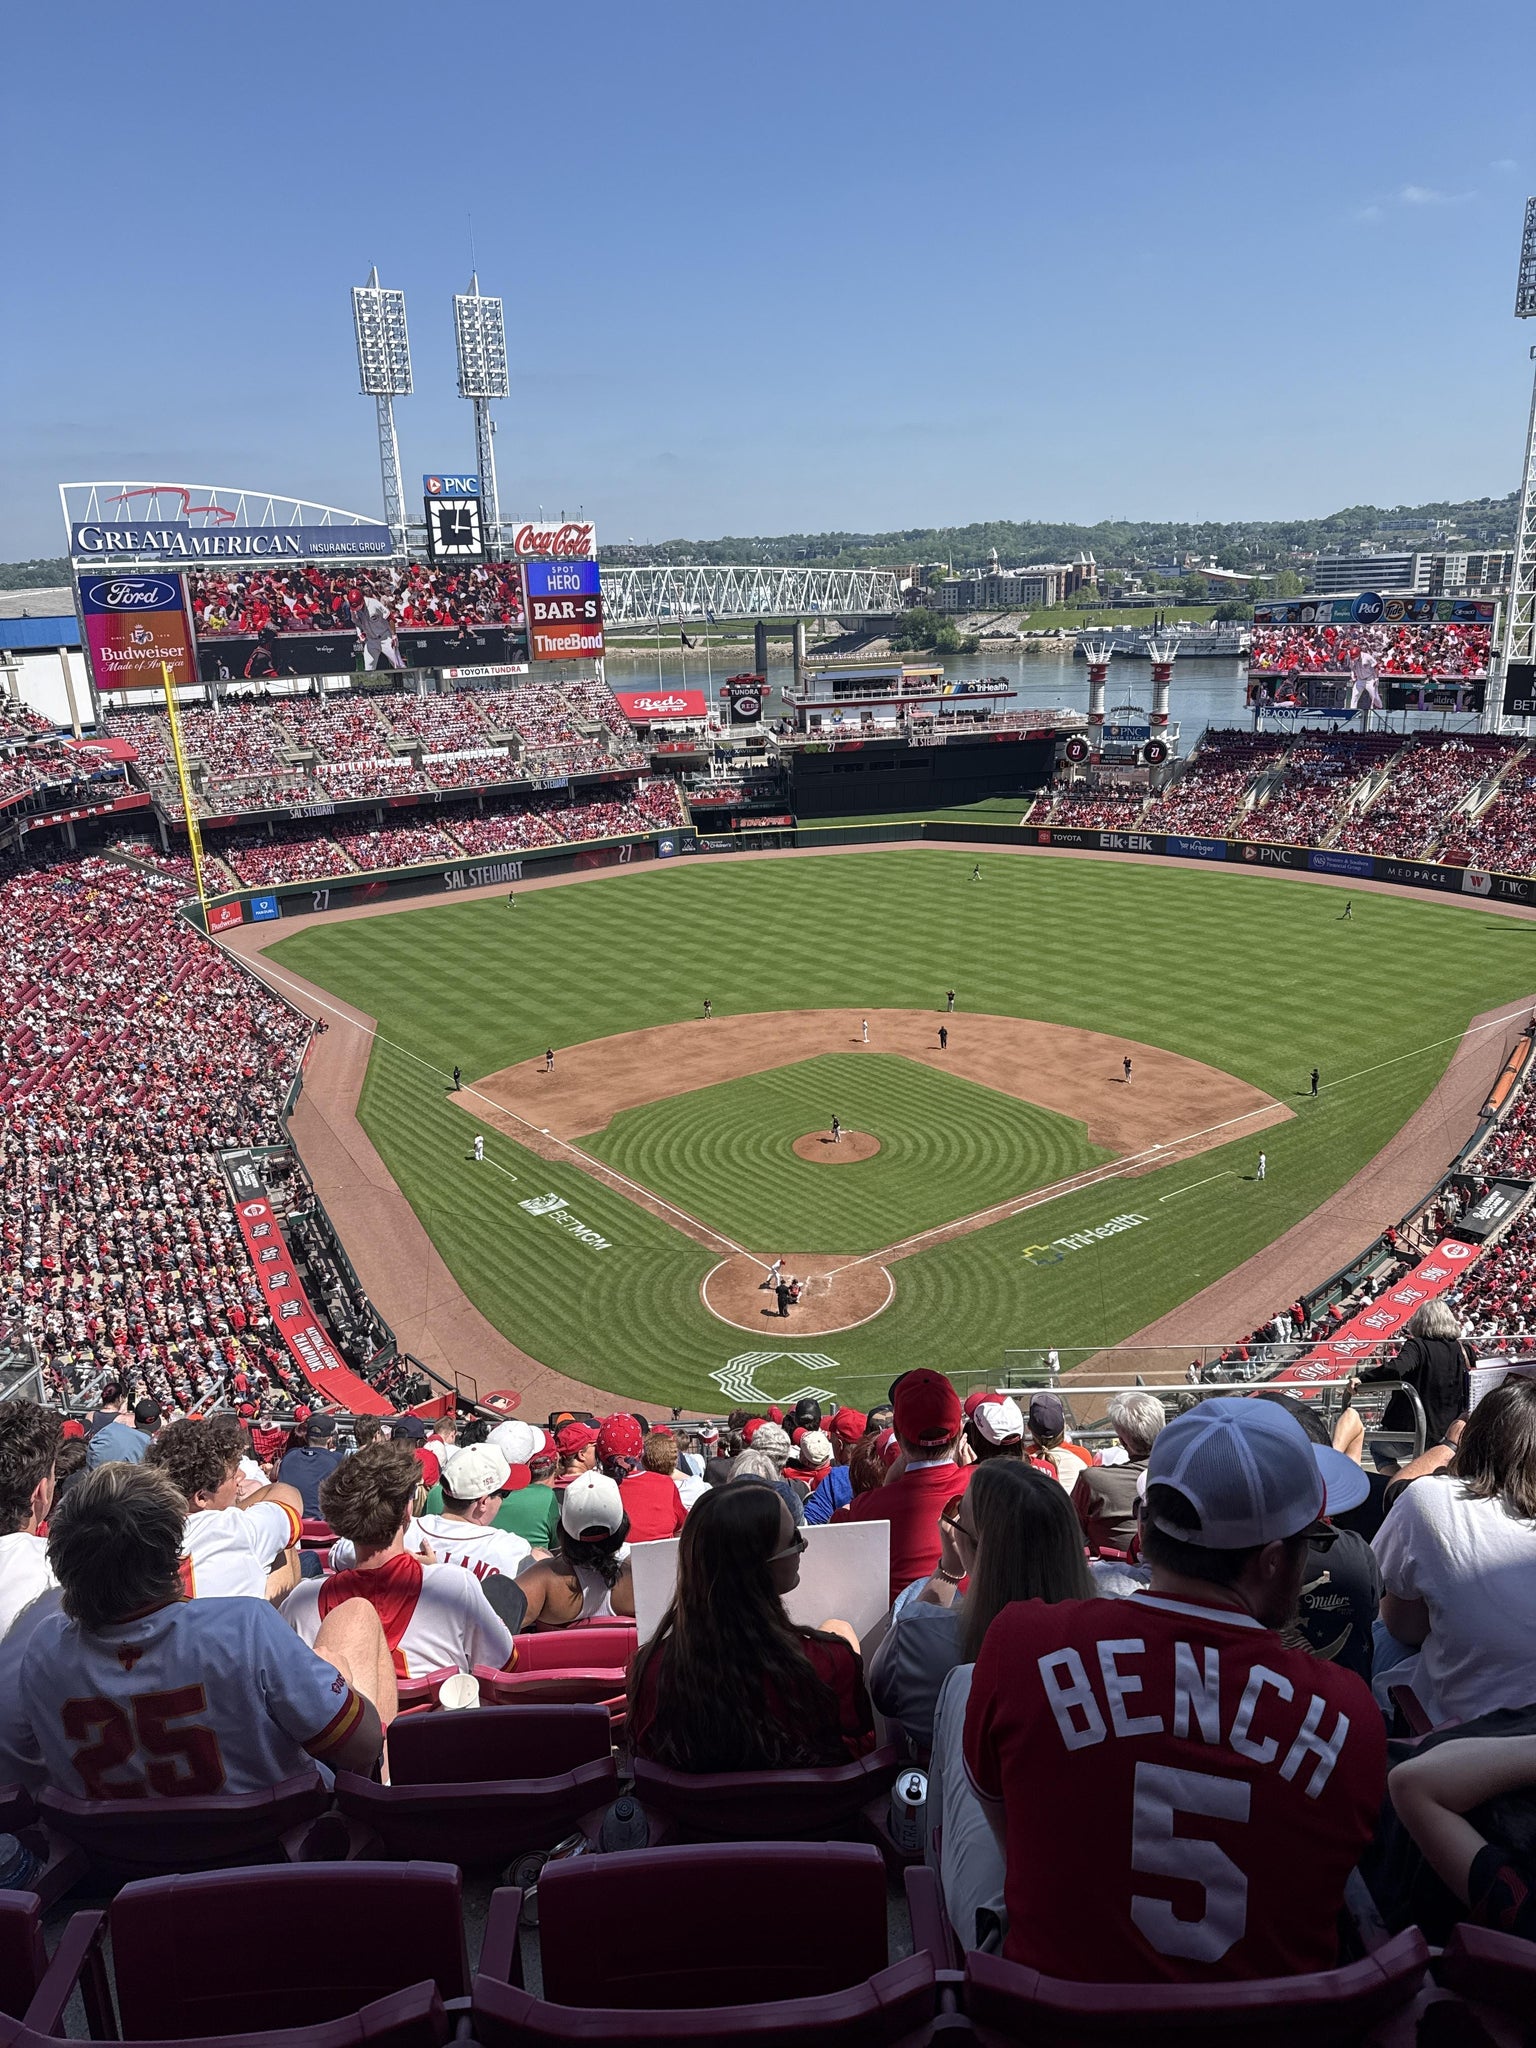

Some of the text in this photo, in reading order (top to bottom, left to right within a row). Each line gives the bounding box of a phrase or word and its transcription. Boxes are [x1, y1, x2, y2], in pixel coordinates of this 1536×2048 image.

[444, 478, 477, 493] PNC
[78, 527, 172, 551] GREAT
[310, 542, 358, 552] INSURANCE
[359, 542, 386, 552] GROUP
[552, 566, 574, 574] SPOT
[547, 574, 580, 591] HERO
[107, 582, 159, 605] Ford
[534, 600, 596, 620] BAR-S
[1358, 602, 1380, 614] P&G
[1386, 604, 1404, 616] Tide
[534, 632, 602, 652] ThreeBond
[100, 645, 185, 661] Budweiser
[101, 659, 184, 673] Made of Amrica
[460, 666, 522, 676] TOYOTA TUNDRA
[730, 688, 759, 696] TUNDRA
[975, 682, 1008, 692] TriHealth
[633, 696, 688, 711] Reds
[1259, 707, 1297, 719] BEACON
[1018, 730, 1027, 740] 27
[1120, 727, 1142, 736] PNC
[828, 743, 835, 752] 27
[908, 737, 920, 747] SAL
[1072, 745, 1080, 756] 27
[1150, 747, 1160, 758] 27
[290, 805, 336, 819] SAL STEWART
[1053, 834, 1082, 842] TOYOTA
[619, 844, 632, 863] 27
[1189, 841, 1215, 855] Kroger
[1260, 848, 1292, 864] PNC
[444, 861, 523, 890] SAL STEWART
[1388, 867, 1446, 883] MEDPACE
[1470, 876, 1484, 887] W
[1500, 880, 1528, 895] TWC
[312, 889, 330, 912] 27
[211, 916, 242, 932] Budweiser
[548, 1210, 612, 1250] BETMGM
[1052, 1214, 1150, 1250] TriHealth
[1393, 1288, 1422, 1304] 1976
[282, 1300, 300, 1318] 1972
[1365, 1311, 1395, 1329] 1975
[292, 1332, 324, 1372] CHAMPIONS
[306, 1326, 340, 1370] NATIONAL LEAGUE
[1298, 1363, 1331, 1380] 1919
[1304, 1594, 1350, 1610] Miller
[1038, 1638, 1352, 1799] BENCH
[60, 1682, 226, 1798] 25
[903, 1824, 917, 1849] LTRA
[1130, 1761, 1250, 1963] 5
